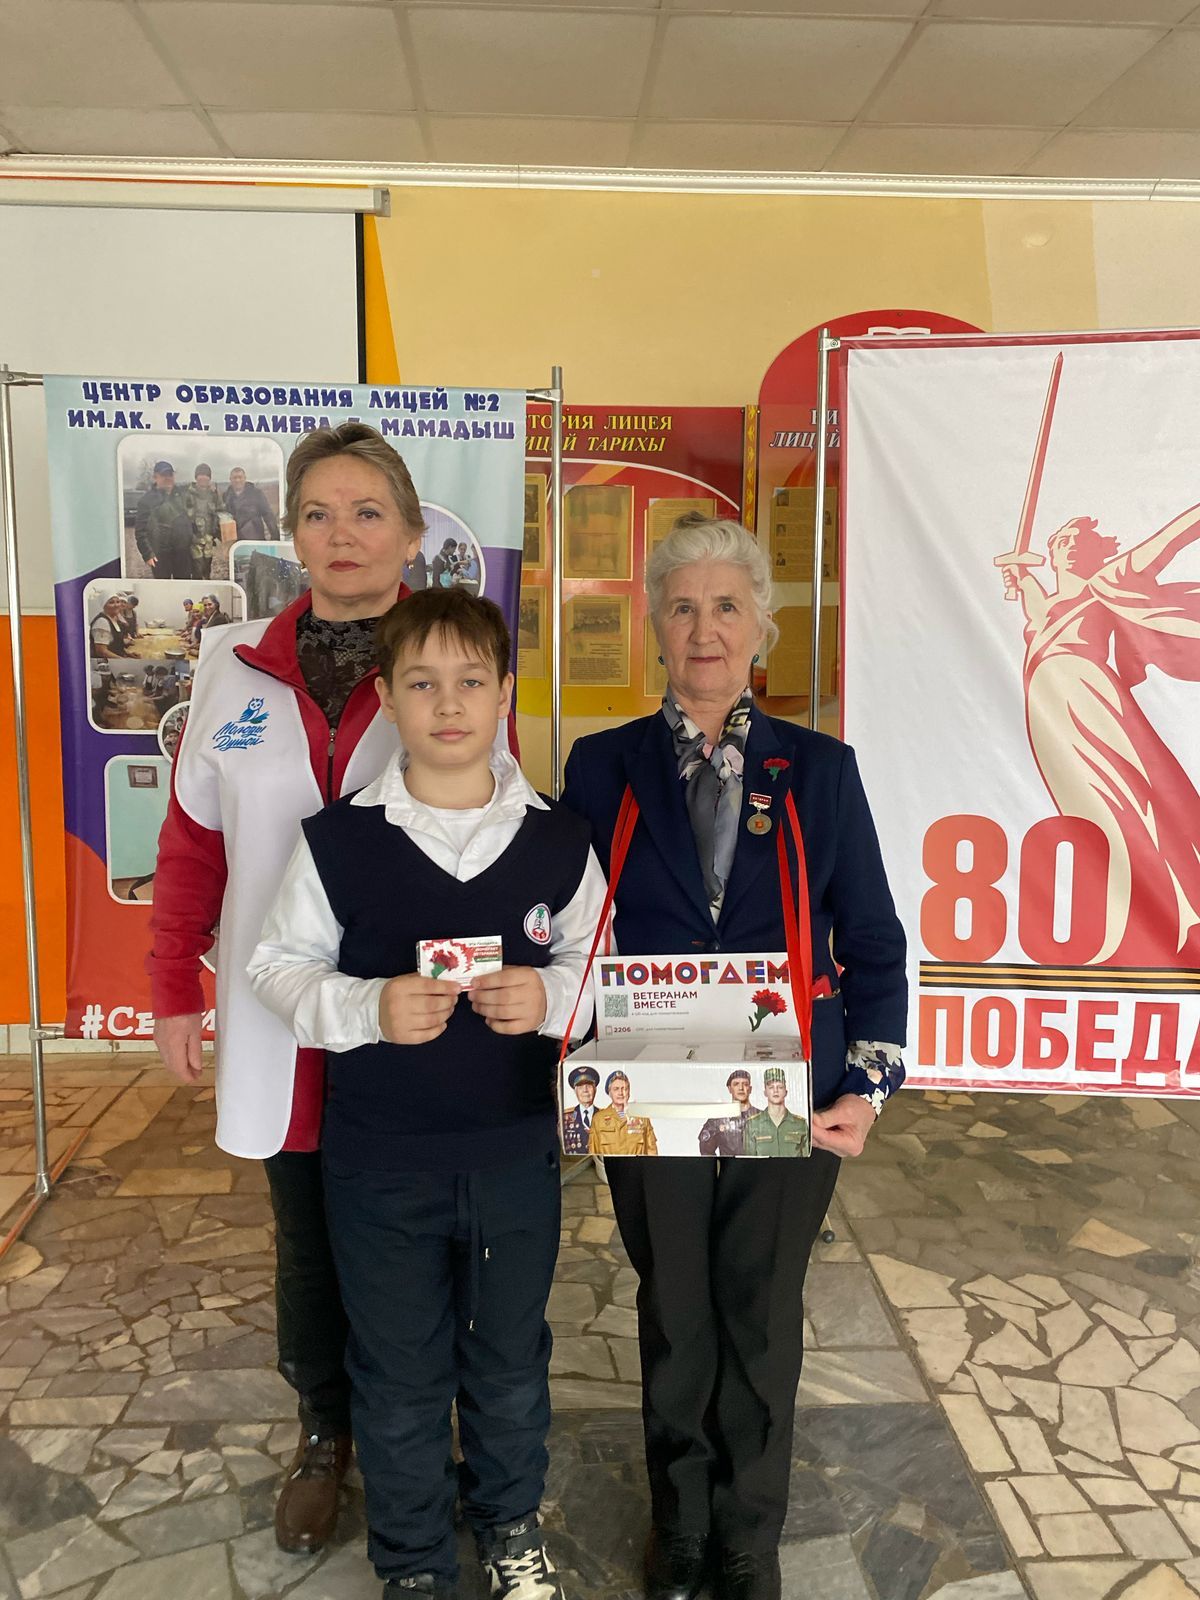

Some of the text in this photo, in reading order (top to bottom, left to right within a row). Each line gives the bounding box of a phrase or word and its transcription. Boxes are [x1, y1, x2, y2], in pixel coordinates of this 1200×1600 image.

[81, 381, 500, 413] ЦЕНТР ОБРАЗОВАНИЯ ЛИЦЕЙ №2
[165, 412, 211, 431] К.А.
[224, 413, 331, 434] ВАЛИЕВА
[380, 418, 515, 440] МАМАДЫШ
[603, 415, 673, 433] ЛИЦЕЯ
[587, 437, 667, 452] ТАРИХЫ
[769, 428, 840, 451] ЛИЦЙ
[212, 735, 265, 752] Душой
[919, 813, 1110, 966] 80
[600, 960, 790, 987] ПОМОГАЕМ
[632, 991, 698, 1000] ВЕТЕРАНАМ
[633, 1000, 677, 1009] ВМЕСТЕ
